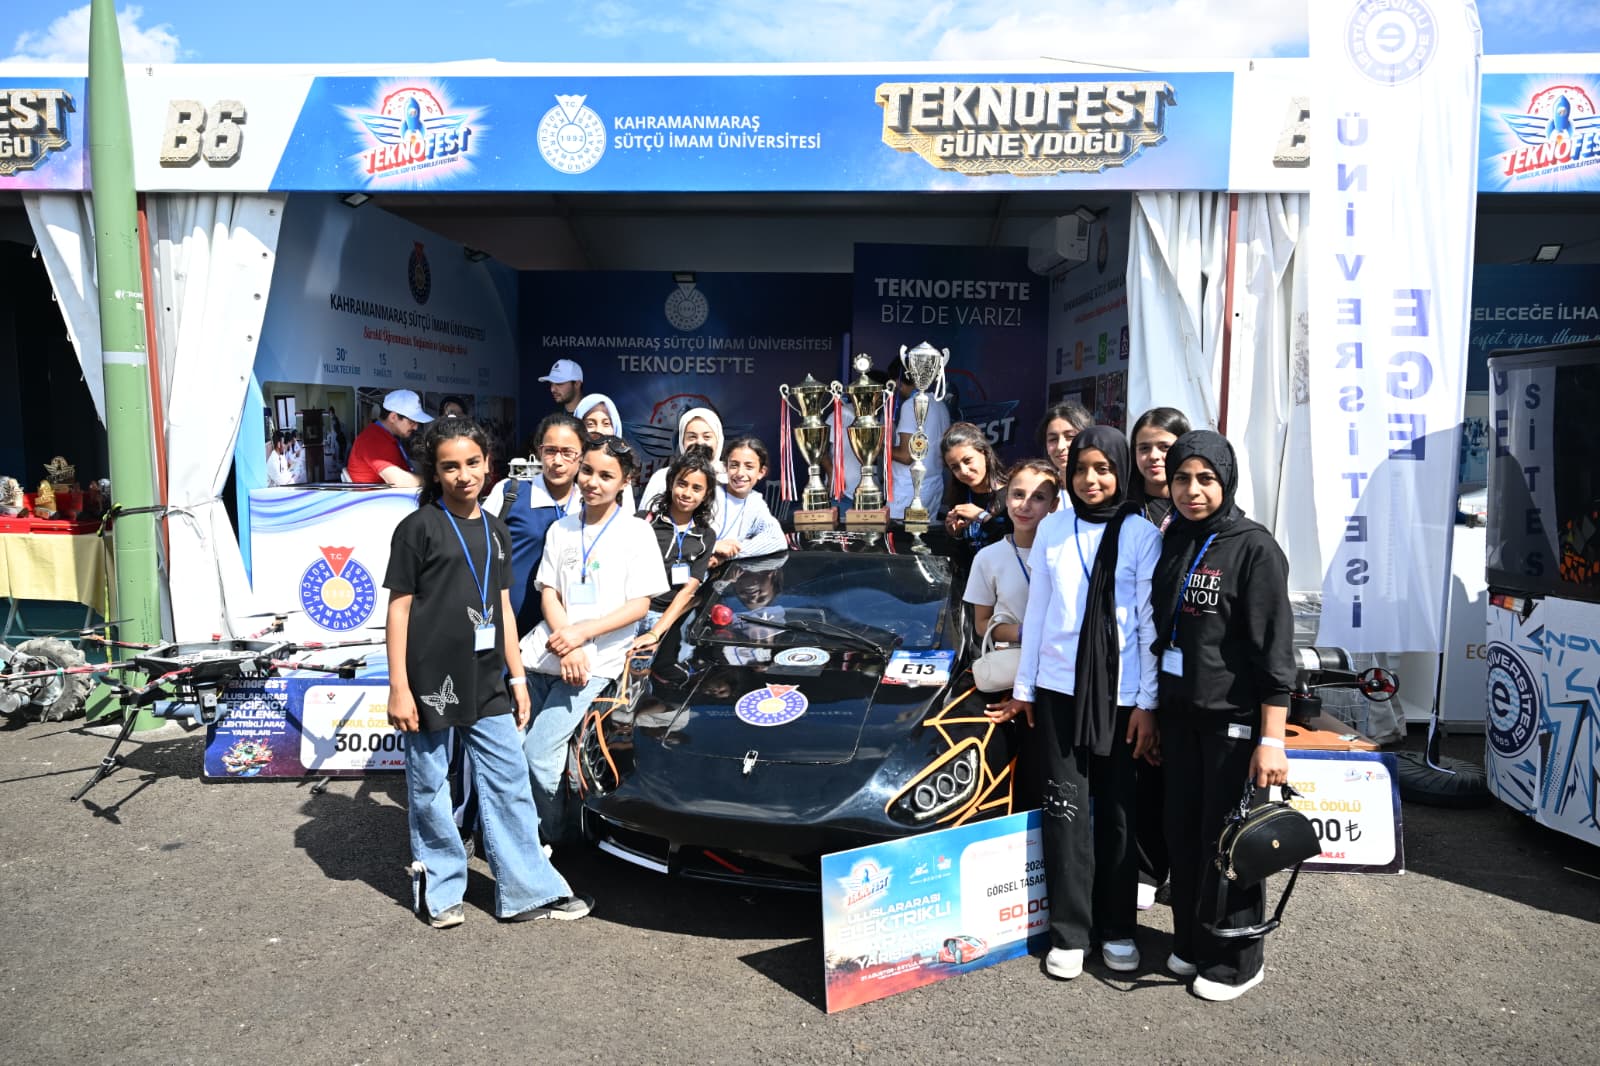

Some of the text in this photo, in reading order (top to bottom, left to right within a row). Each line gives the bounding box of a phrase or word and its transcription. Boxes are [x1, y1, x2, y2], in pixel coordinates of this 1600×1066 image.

[880, 83, 1175, 132] TEKNOFEST
[160, 99, 246, 168] B6
[614, 114, 761, 134] KAHRAMANMARAŞ
[364, 127, 472, 174] TEKNOFEST
[614, 131, 822, 152] SÜTÇÜ İMAM ÜNİVERSİTESİ
[936, 128, 1127, 158] GÜNEYDOĞU
[874, 277, 1031, 301] TEKNOFEST'TE
[330, 293, 409, 329] KAHRAMANMARAŞ
[408, 310, 431, 332] SÜTÇÜ
[881, 300, 1022, 327] BİZ DE VARIZ!
[1470, 303, 1554, 321] ELECEĞE
[542, 335, 833, 353] KAHRAMANMARAŞ SÜTÇÜ İMAM ÜNİVERSİTESİ
[379, 353, 387, 366] 15
[617, 354, 755, 374] TEKNOFEST'TE
[1191, 590, 1218, 606] YOU
[901, 663, 936, 675] E13
[231, 729, 271, 738] YARIŞLARI
[331, 719, 365, 728] KURUL
[1320, 799, 1361, 813] ÖDÜLÜ
[987, 878, 1018, 898] GÖRSEL
[847, 892, 941, 924] ULUSLARARASI
